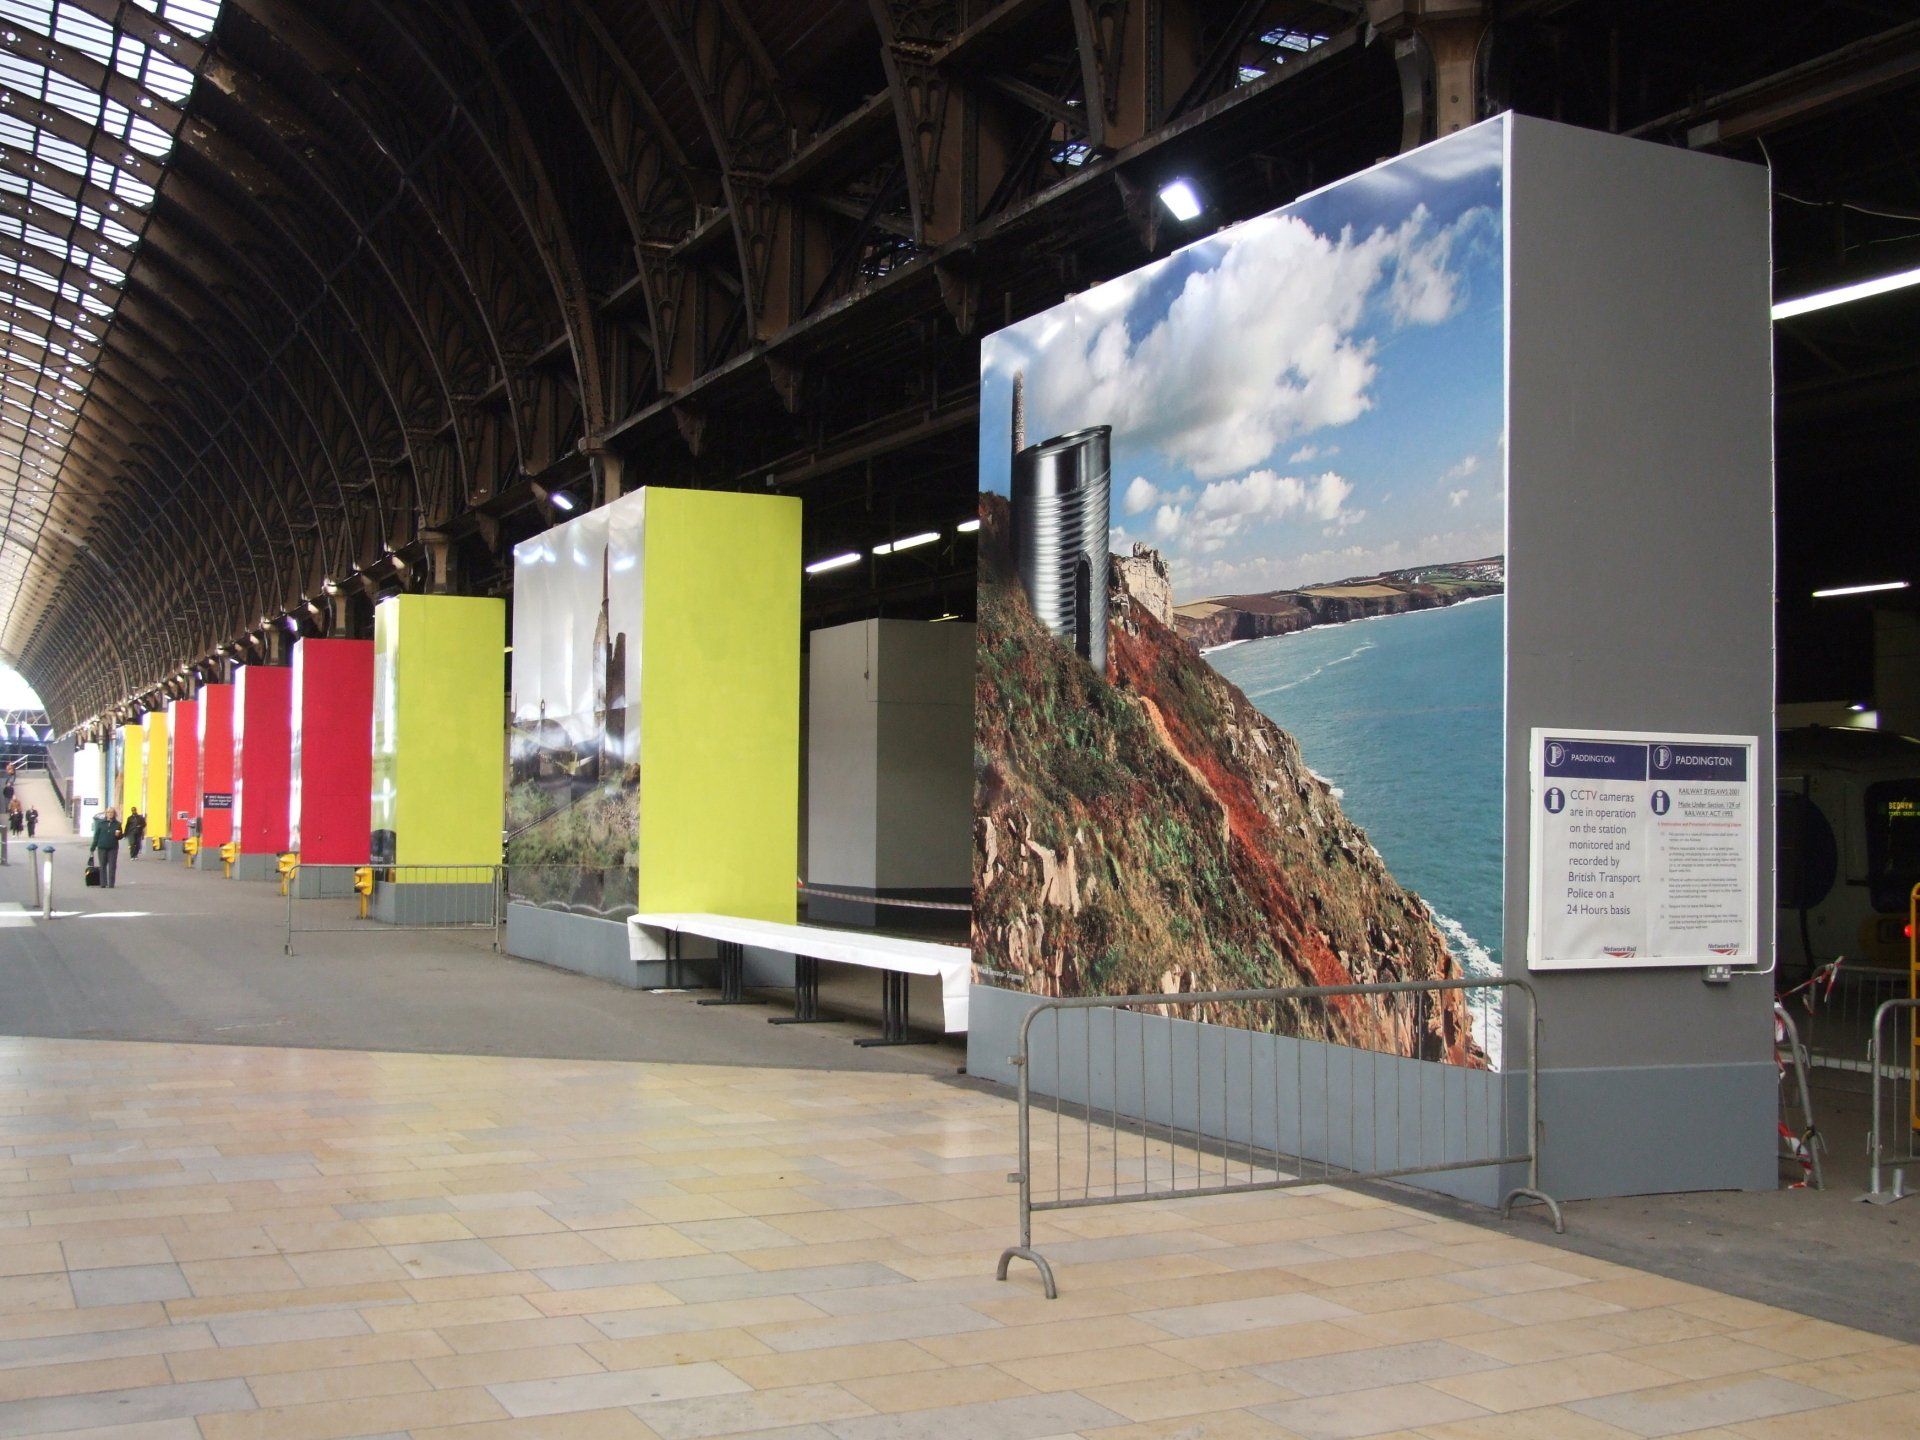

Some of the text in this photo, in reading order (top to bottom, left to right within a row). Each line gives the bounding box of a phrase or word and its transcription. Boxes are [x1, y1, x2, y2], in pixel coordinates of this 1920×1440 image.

[1571, 753, 1615, 763] PADDINGTON
[1675, 755, 1732, 766] PADDINGTON
[1570, 789, 1635, 803] CCTV cameras
[1679, 787, 1703, 795] RAILWAY
[1569, 807, 1637, 820] are in operation
[1569, 823, 1627, 834] on the station
[1569, 840, 1631, 850] monitored and
[1569, 856, 1620, 869] recorded by
[1568, 871, 1641, 885] British Transport
[1567, 887, 1594, 898] Police
[1595, 890, 1607, 898] on
[1567, 904, 1631, 915] 24 Hours basis
